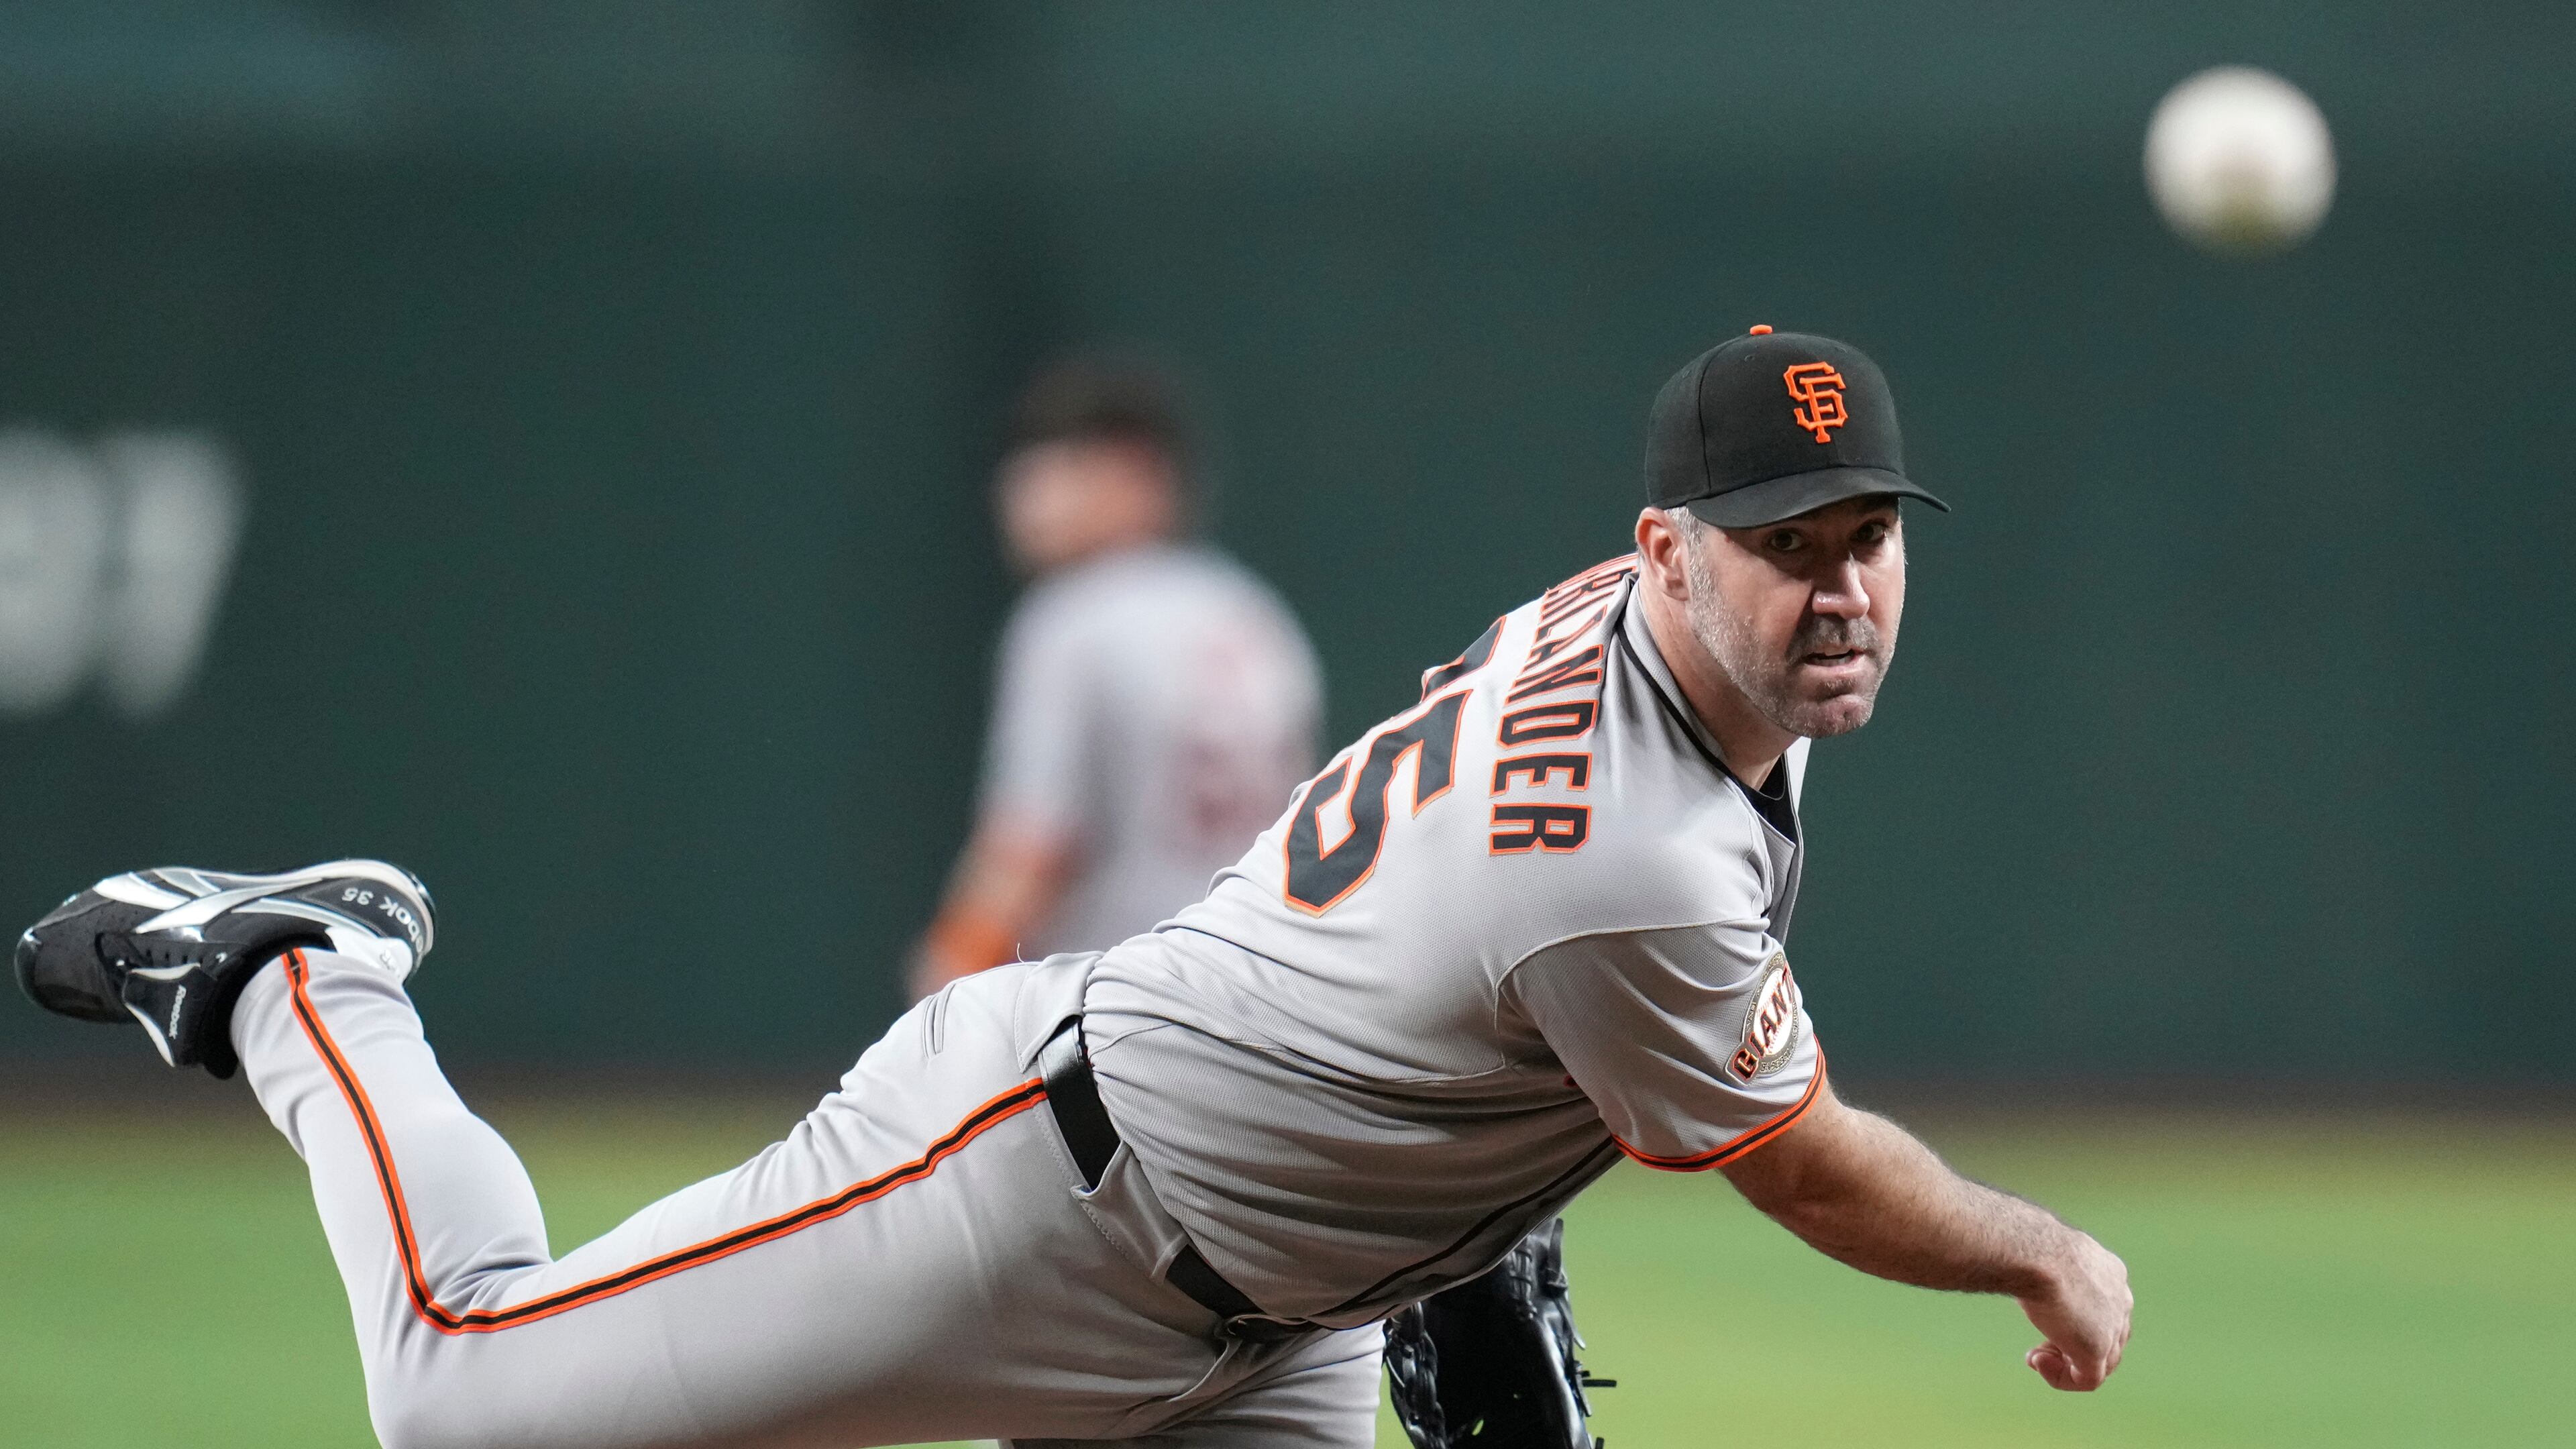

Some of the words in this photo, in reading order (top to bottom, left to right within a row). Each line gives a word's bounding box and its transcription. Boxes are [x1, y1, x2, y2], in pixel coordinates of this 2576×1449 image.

[1488, 553, 1639, 856] RLANDER
[341, 887, 374, 905] 35
[168, 984, 186, 1040] Reebok
[1732, 962, 1795, 1080] GIANT
